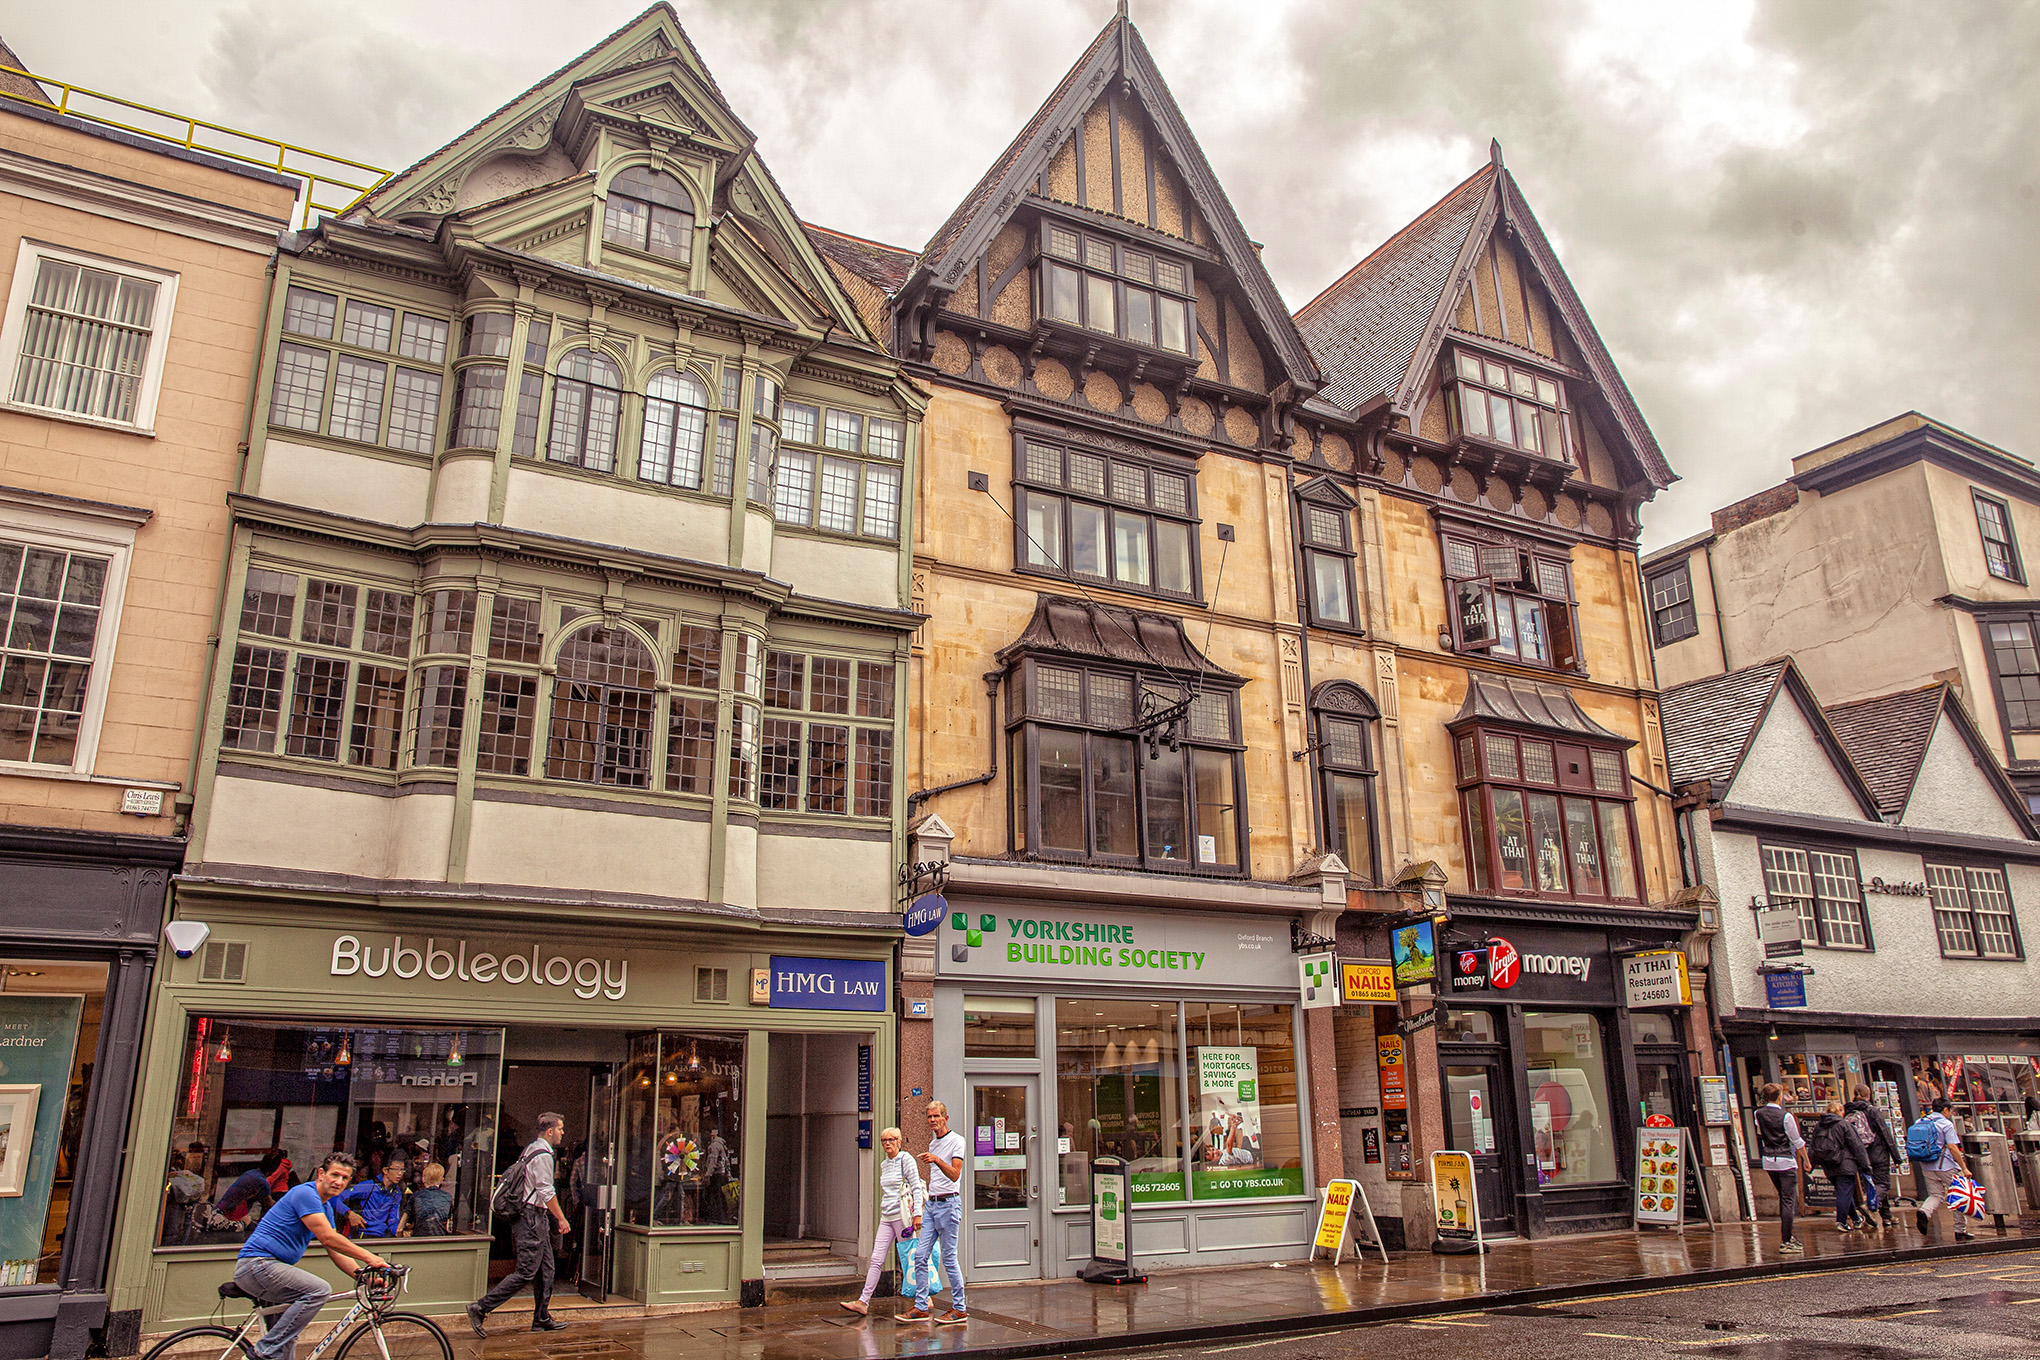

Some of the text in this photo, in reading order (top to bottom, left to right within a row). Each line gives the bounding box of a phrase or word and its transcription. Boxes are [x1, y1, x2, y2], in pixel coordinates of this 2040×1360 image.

[1469, 603, 1482, 614] AT
[126, 790, 142, 799] Chris
[1507, 836, 1518, 846] AT
[1544, 838, 1554, 848] AT
[1502, 846, 1524, 858] THAI
[1580, 842, 1589, 852] AT
[1540, 850, 1560, 861] THAI
[1576, 852, 1596, 864] THAI
[1870, 876, 1925, 896] Dentist
[908, 906, 942, 928] HMG LAW
[1007, 918, 1134, 944] YORKSHIRE
[1237, 934, 1273, 943] Oxford Branch
[1238, 942, 1262, 951] ybs.co.uk
[1007, 942, 1205, 970] BUILDING SOCIETY
[330, 935, 628, 1000] Bubbleology
[1357, 967, 1381, 975] OXFORD
[1522, 954, 1591, 982] money
[1628, 960, 1671, 974] AT THAI
[776, 972, 880, 996] HMG LAW
[1349, 975, 1391, 990] NAILS
[1454, 976, 1485, 987] money
[1629, 975, 1672, 988] Restaurant
[1634, 989, 1670, 1001] t: 245603
[913, 1003, 926, 1013] ADT
[0, 1035, 47, 1047] ardner
[1380, 1040, 1400, 1049] NAILS
[1203, 1062, 1253, 1070] MORTGAGES,
[1152, 1183, 1180, 1192] 723605
[1220, 1181, 1231, 1189] GO
[1245, 1178, 1284, 1188] YBS.CO.UK
[1327, 1194, 1350, 1206] NAILS
